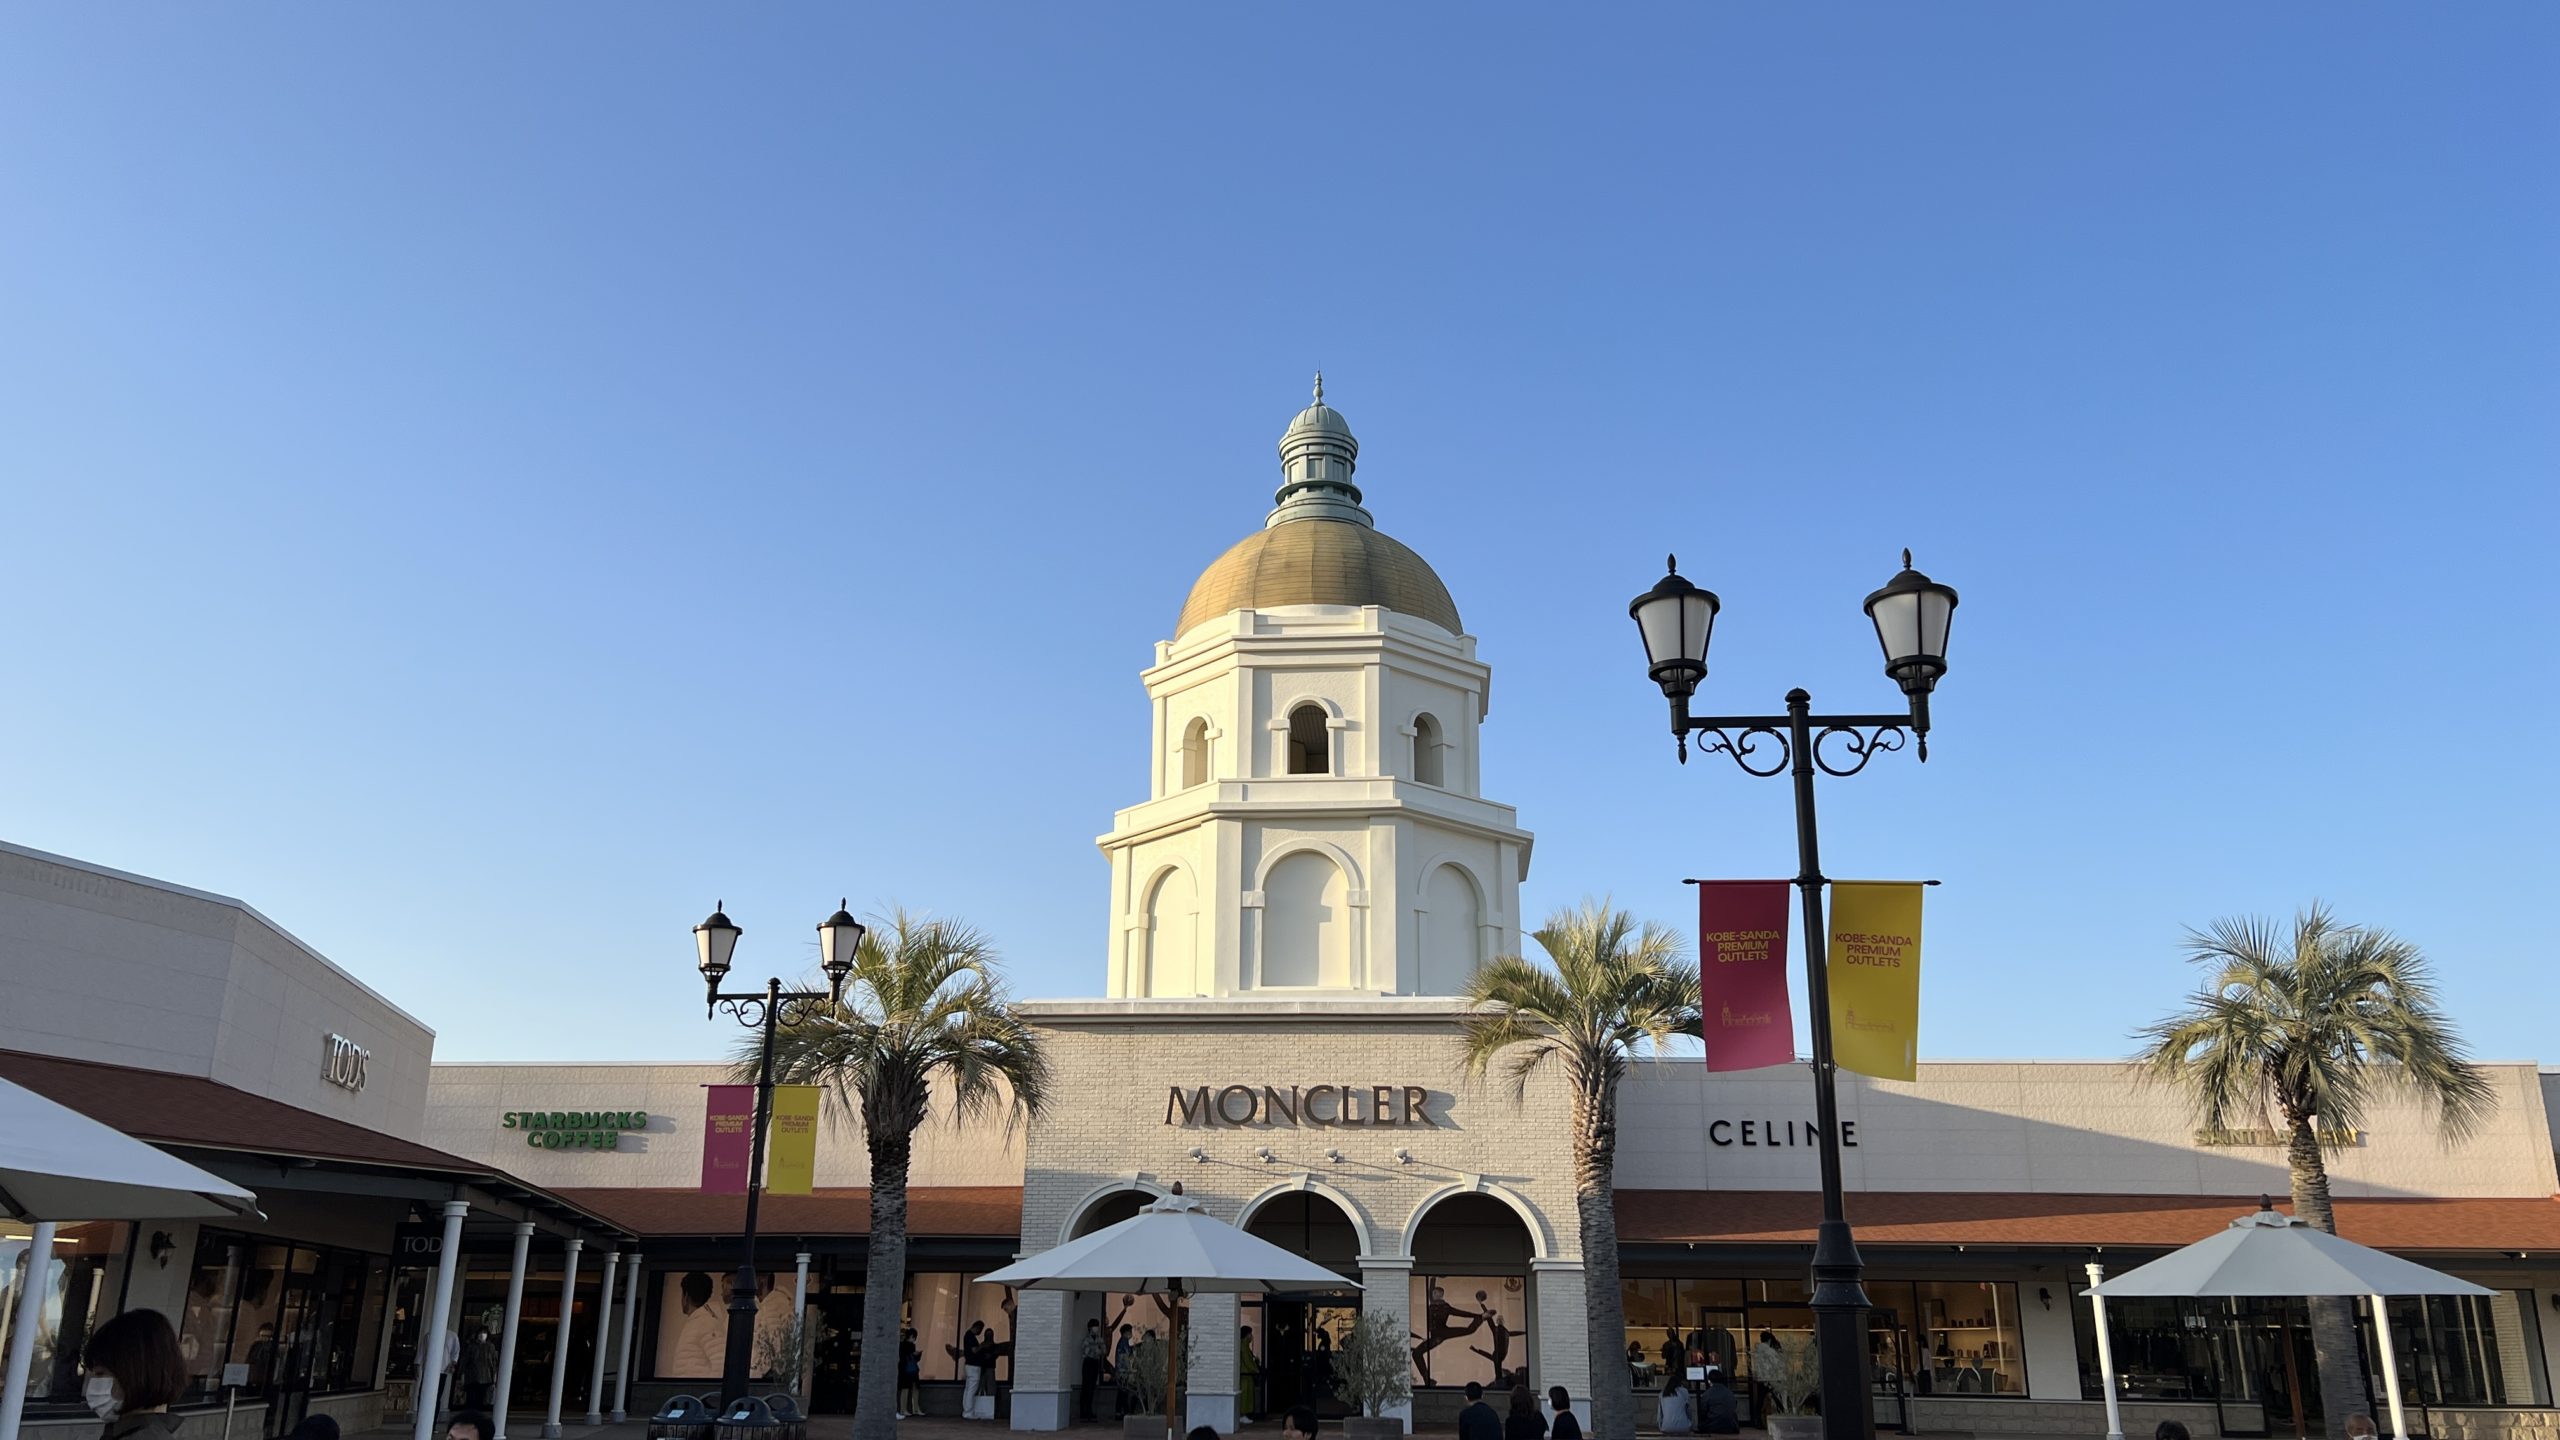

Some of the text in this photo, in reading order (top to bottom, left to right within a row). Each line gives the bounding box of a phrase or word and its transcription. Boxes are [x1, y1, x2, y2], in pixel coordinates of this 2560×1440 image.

[1706, 930, 1780, 943] KOBE-SANDA
[1835, 933, 1913, 946] KOBE-SANDA
[1717, 940, 1769, 952] PREMIUM
[1846, 944, 1901, 957] PREMIUM
[1717, 951, 1769, 963] OUTLETS
[1846, 955, 1901, 968] OUTLETS
[329, 1032, 371, 1092] TOD'S
[1164, 1084, 1437, 1126] MONCLER
[502, 1111, 648, 1129] STARBUCKS
[1709, 1119, 1858, 1147] CELINE
[527, 1131, 618, 1149] COFFEE
